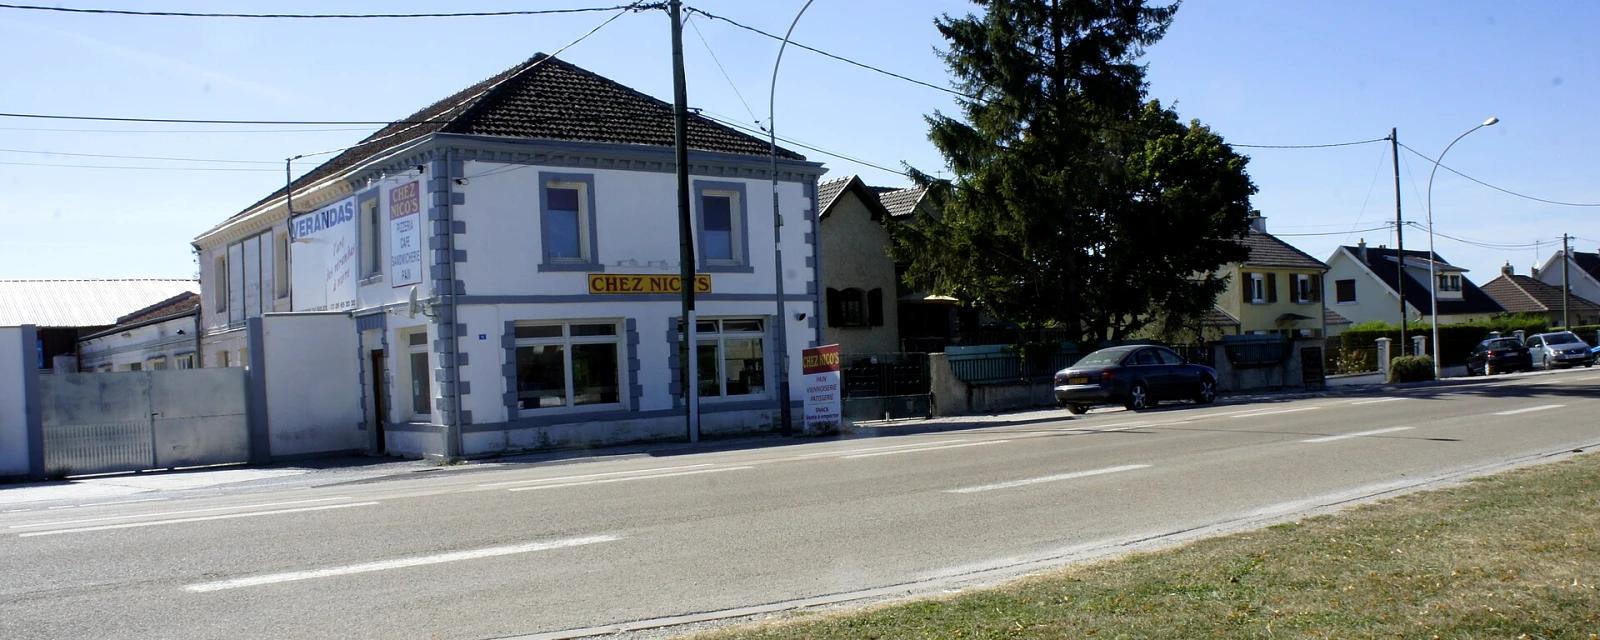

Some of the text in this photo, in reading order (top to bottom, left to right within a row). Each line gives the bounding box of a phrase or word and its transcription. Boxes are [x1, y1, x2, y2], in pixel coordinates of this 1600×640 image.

[392, 183, 416, 202] CHEZ
[391, 198, 418, 219] NICO'S
[292, 201, 354, 239] VERANDAS
[396, 219, 413, 233] PIZZERIA
[391, 250, 420, 267] SANDWICHERIE
[401, 269, 411, 281] PAIN
[591, 277, 709, 292] CHEZ NIC'S
[803, 351, 839, 368] CHEZ NICO'S
[806, 384, 837, 393] VIENNOISERIE
